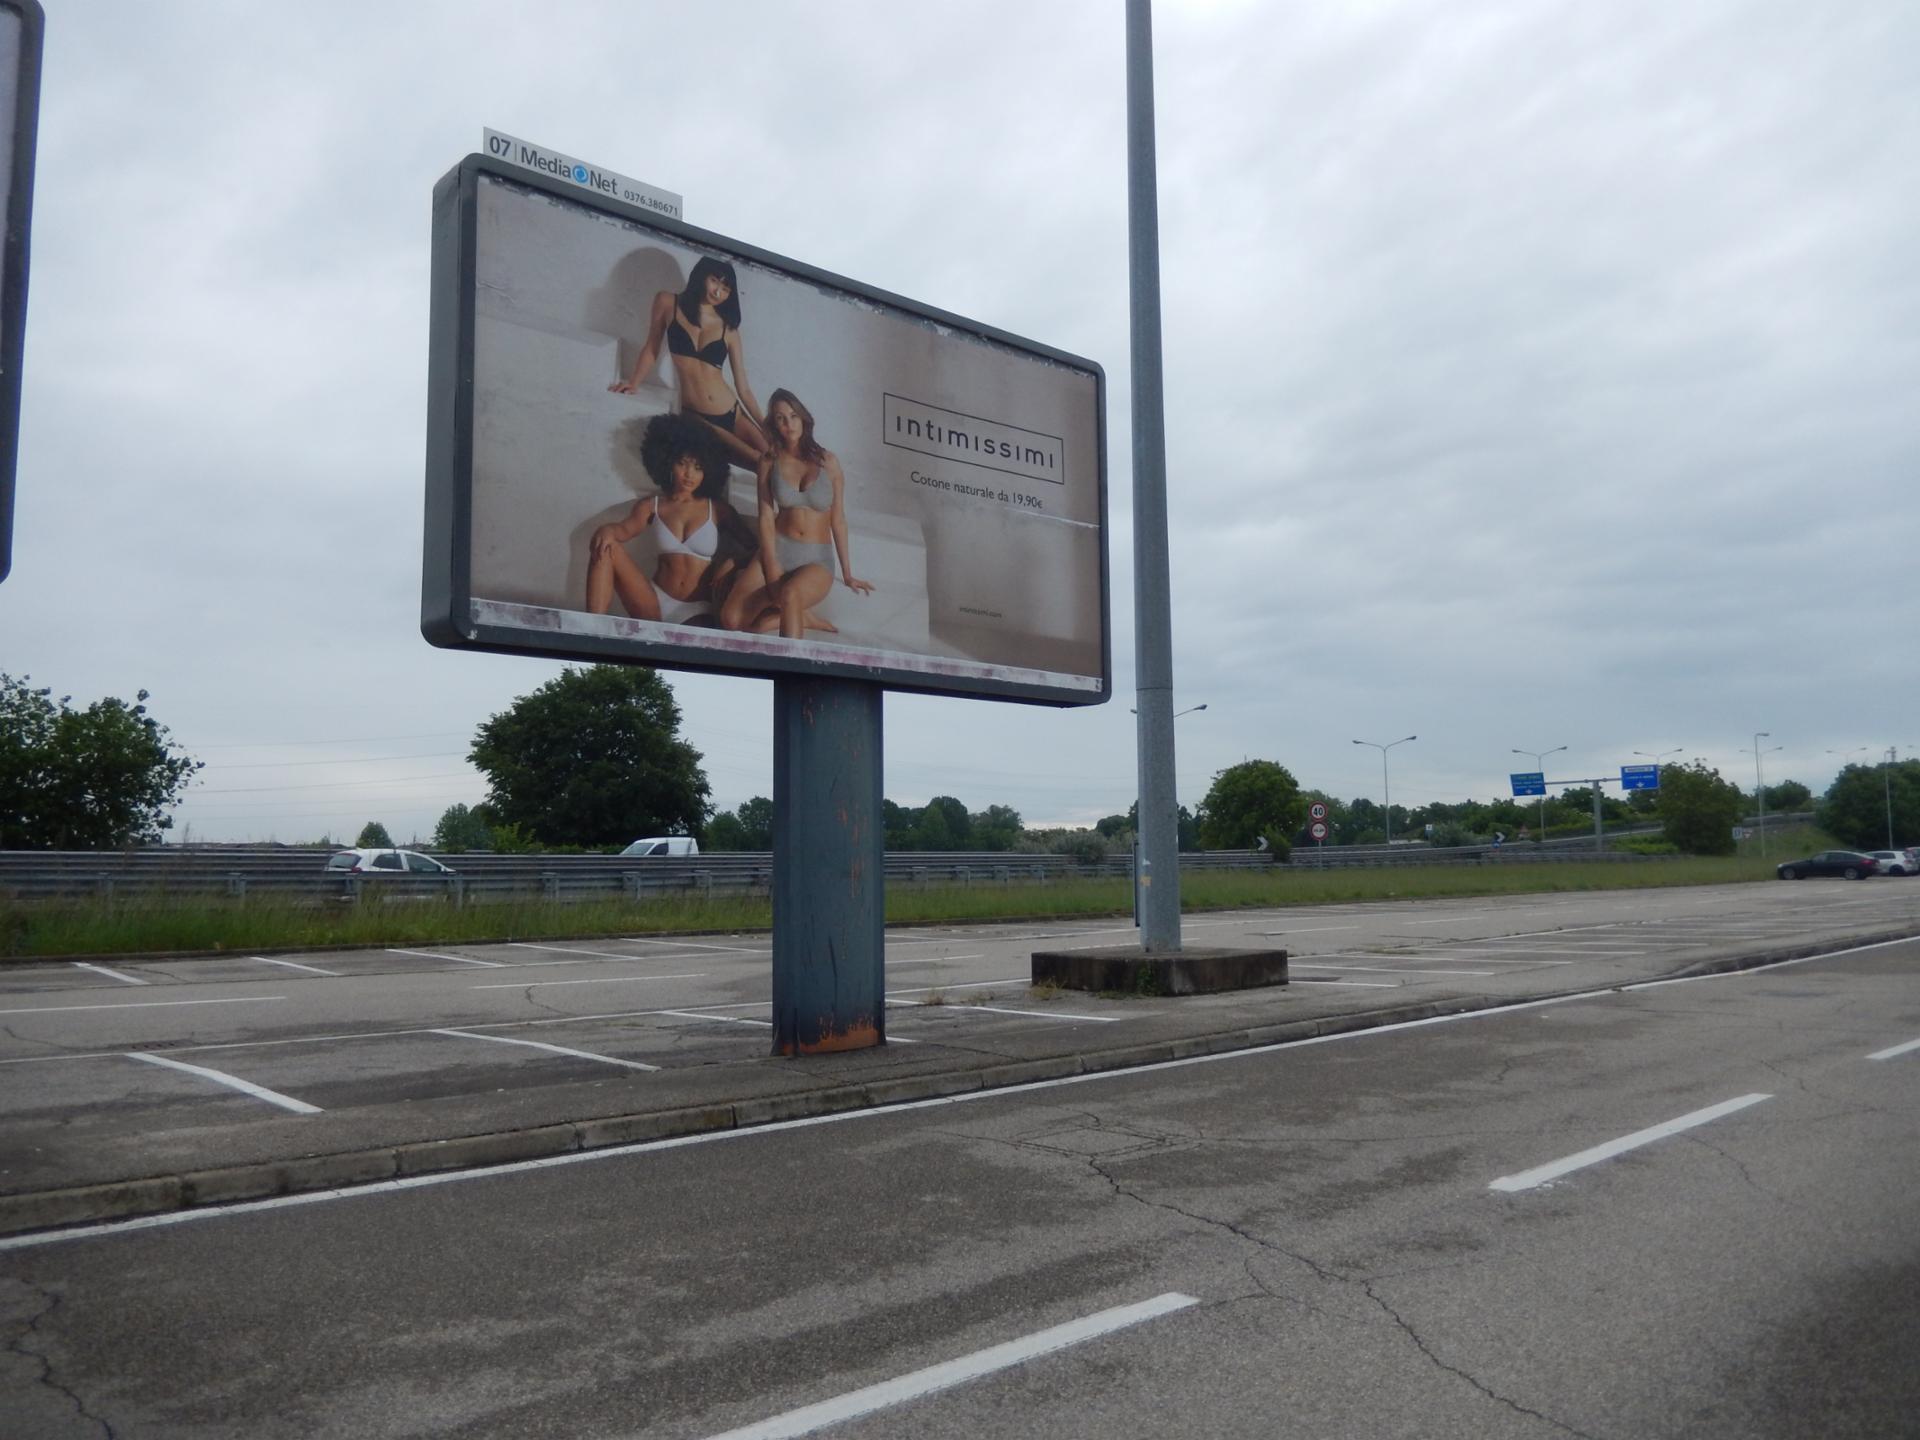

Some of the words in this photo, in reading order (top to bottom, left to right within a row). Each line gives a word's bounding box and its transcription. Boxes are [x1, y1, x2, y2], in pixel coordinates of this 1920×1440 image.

[489, 135, 511, 157] 07
[624, 189, 679, 217] 0376.380671
[896, 415, 1054, 469] intimissimi
[910, 471, 951, 491] Cotone
[954, 482, 995, 500] naturale
[998, 489, 1009, 503] da
[1013, 492, 1043, 509] 19,90€
[1313, 807, 1323, 816] 40
